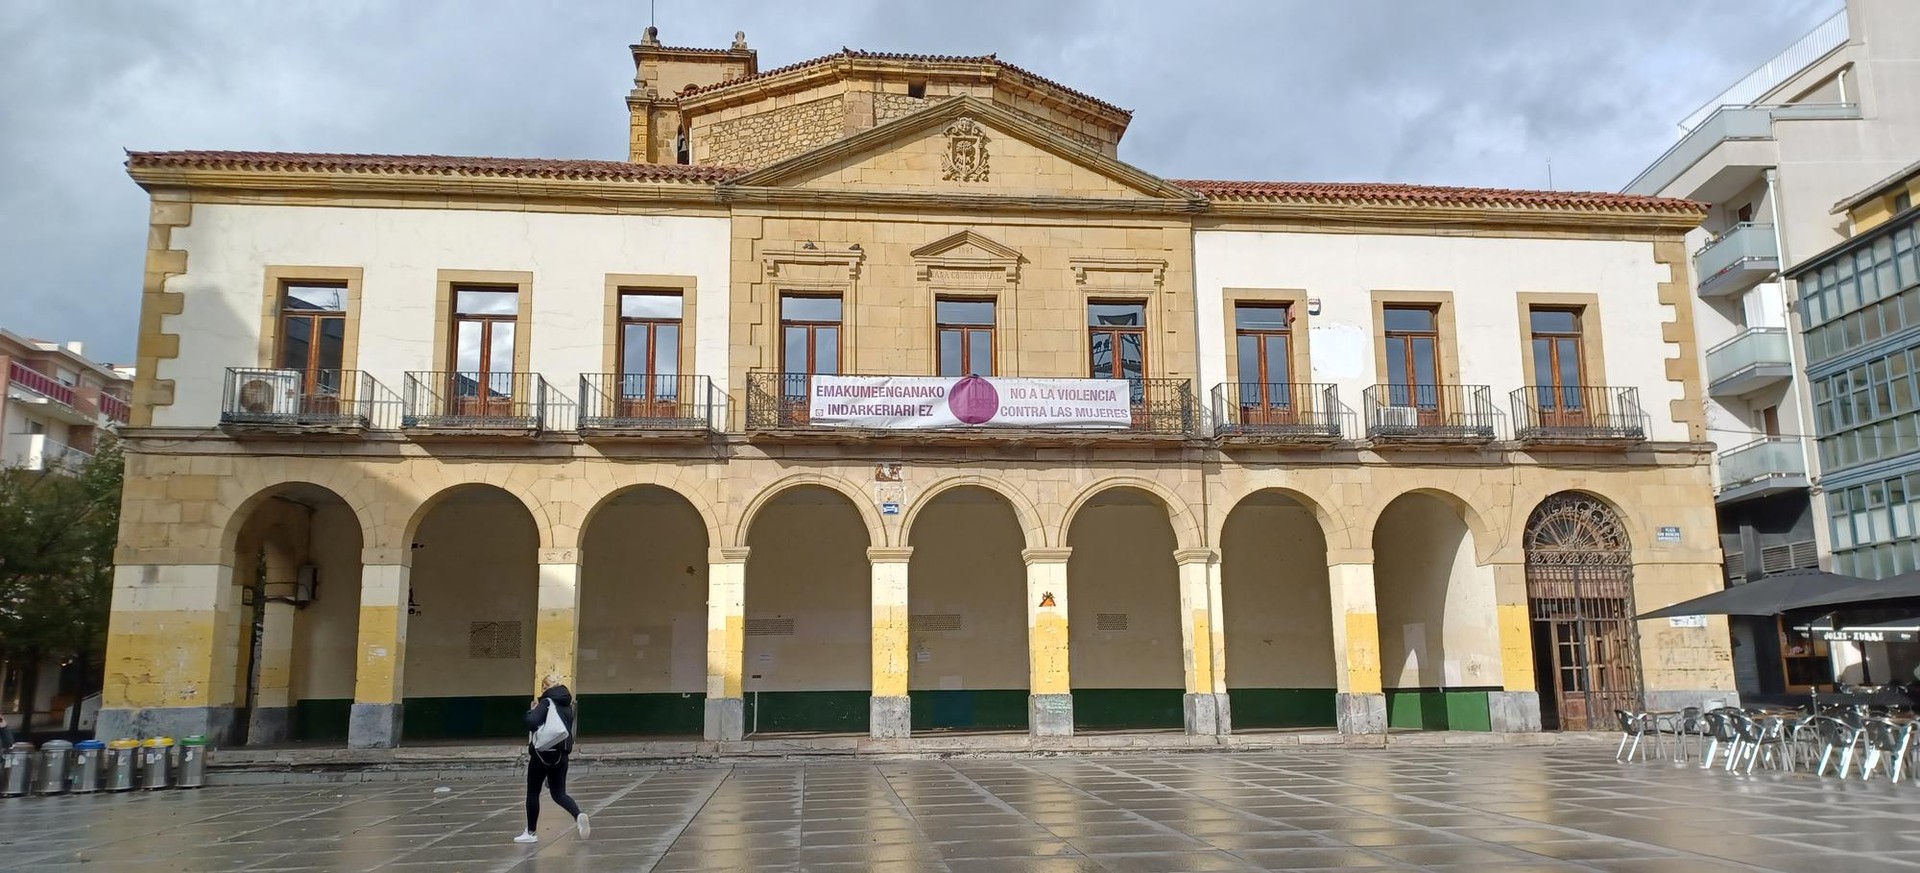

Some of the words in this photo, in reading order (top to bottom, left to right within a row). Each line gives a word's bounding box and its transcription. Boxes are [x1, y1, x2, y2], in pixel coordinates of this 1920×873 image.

[816, 385, 945, 398] EMAKUMEENGANAKO
[1010, 388, 1027, 399] NO
[1029, 388, 1038, 399] A
[1040, 389, 1055, 400] LA
[1057, 389, 1117, 401] VIOLENCIA
[828, 403, 915, 416] INDARKERIARI
[918, 404, 933, 416] EZ
[1000, 406, 1047, 417] CONTRA
[1050, 406, 1072, 417] LAS
[1075, 407, 1128, 419] MUJERES
